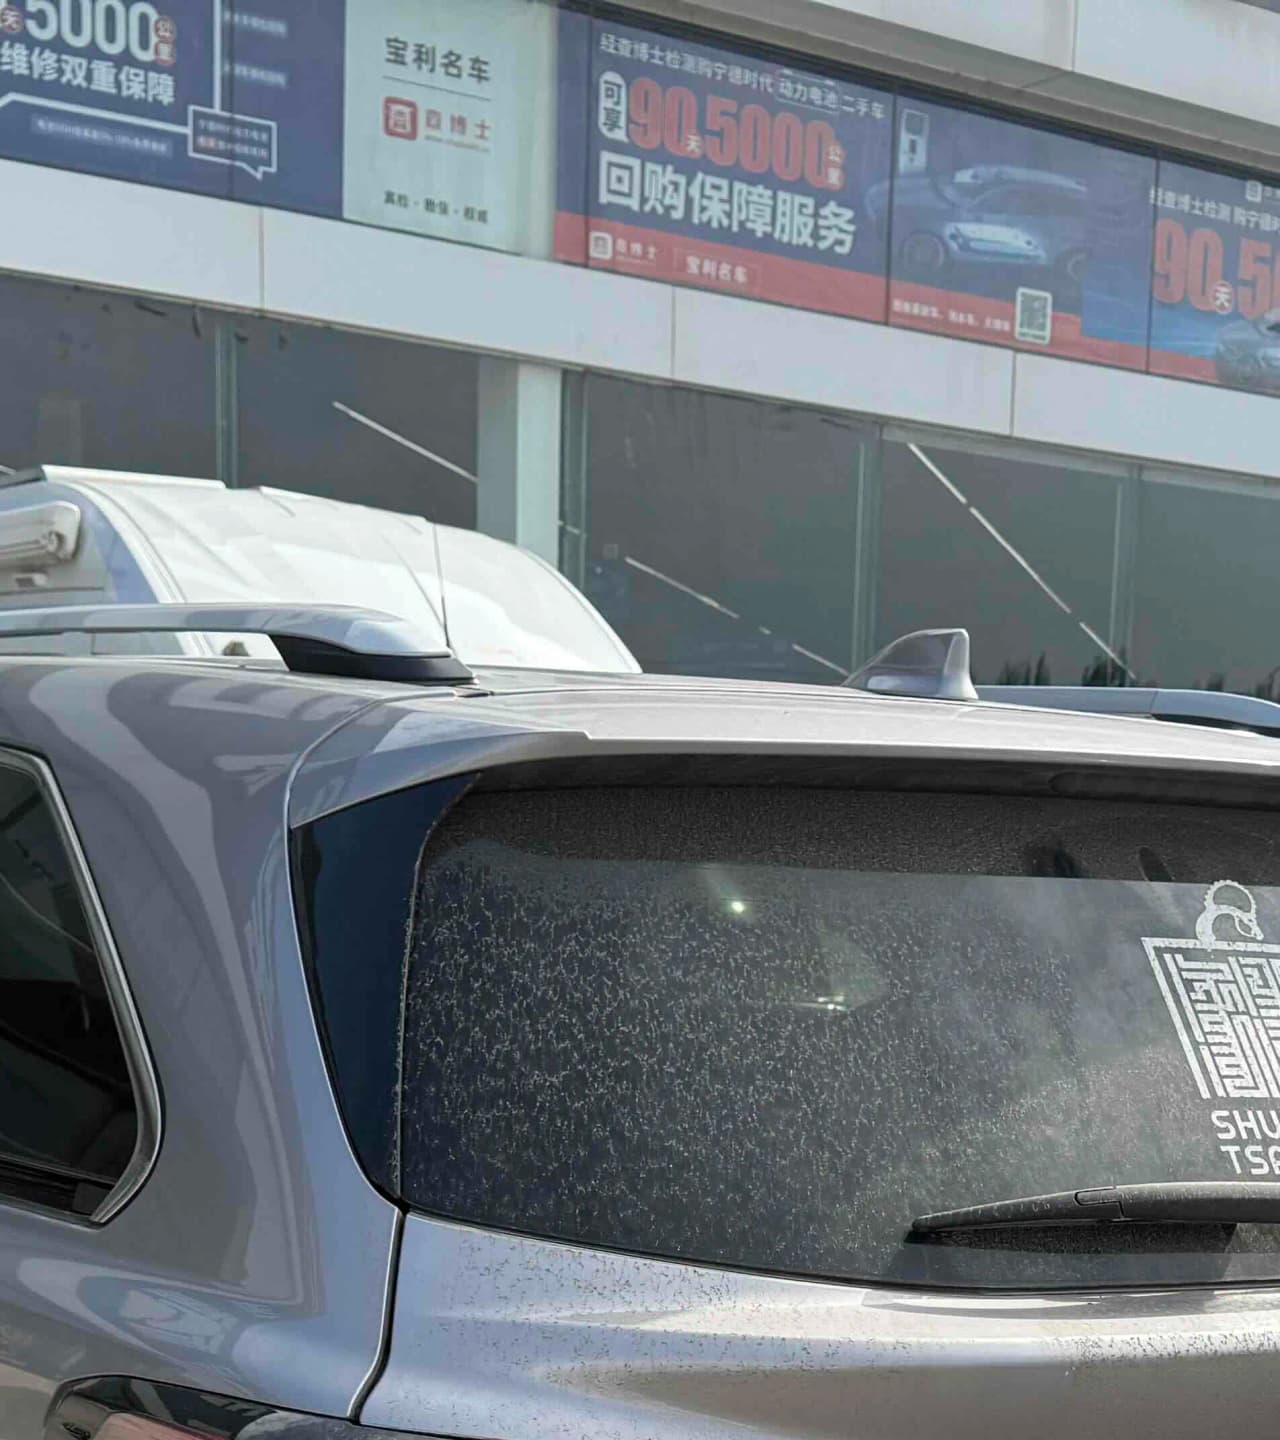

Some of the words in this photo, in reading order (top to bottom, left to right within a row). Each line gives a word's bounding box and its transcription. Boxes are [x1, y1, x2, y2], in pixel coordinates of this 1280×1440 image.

[385, 37, 491, 84] 宝利名车
[601, 78, 624, 133] 可享
[599, 150, 856, 255] 回购保障服务
